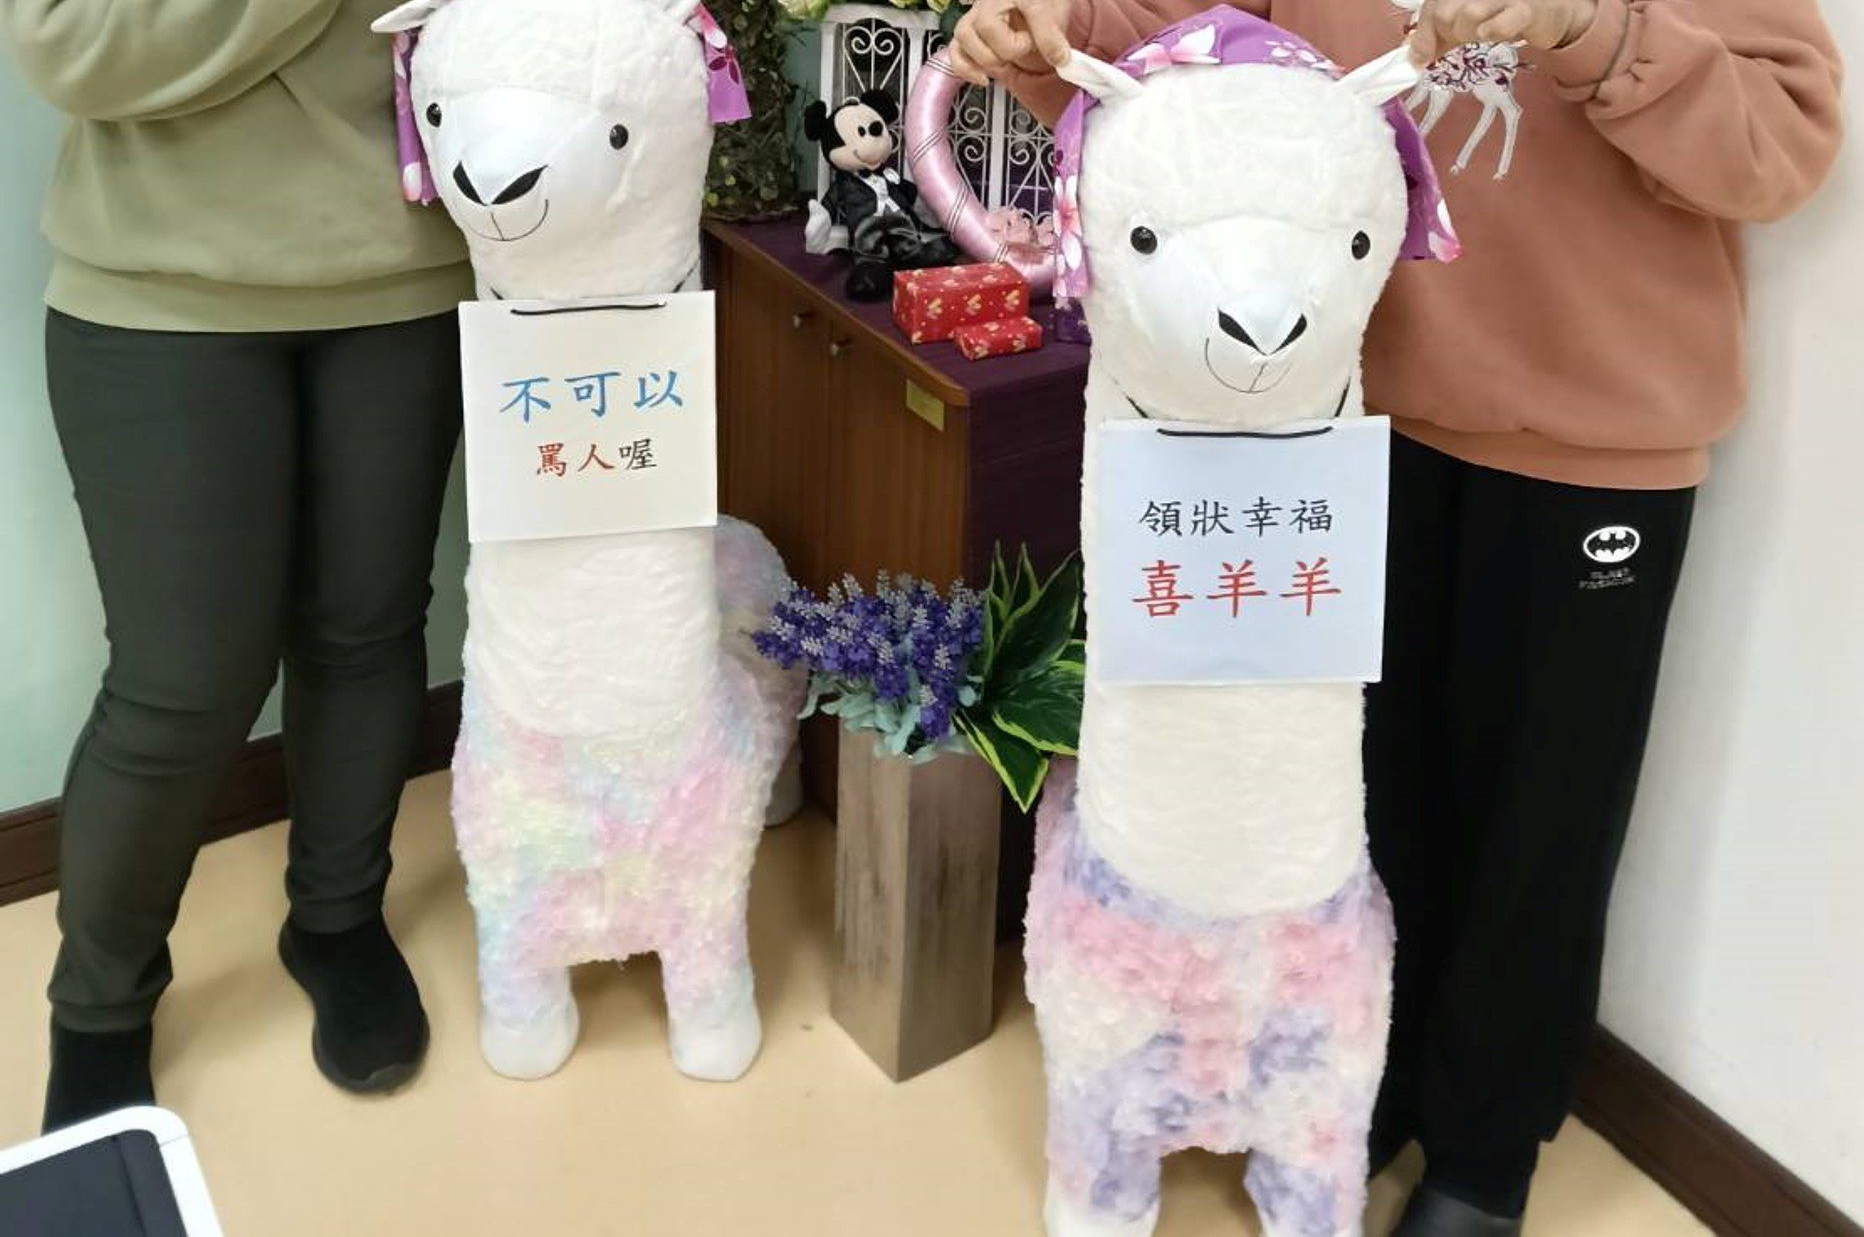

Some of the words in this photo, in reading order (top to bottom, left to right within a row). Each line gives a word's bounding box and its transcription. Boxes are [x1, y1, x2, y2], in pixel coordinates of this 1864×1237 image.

[500, 370, 683, 423] 不可以
[536, 438, 658, 477] 罵人喔
[1138, 495, 1333, 537] 領狀幸福
[1132, 557, 1342, 619] 喜羊羊
